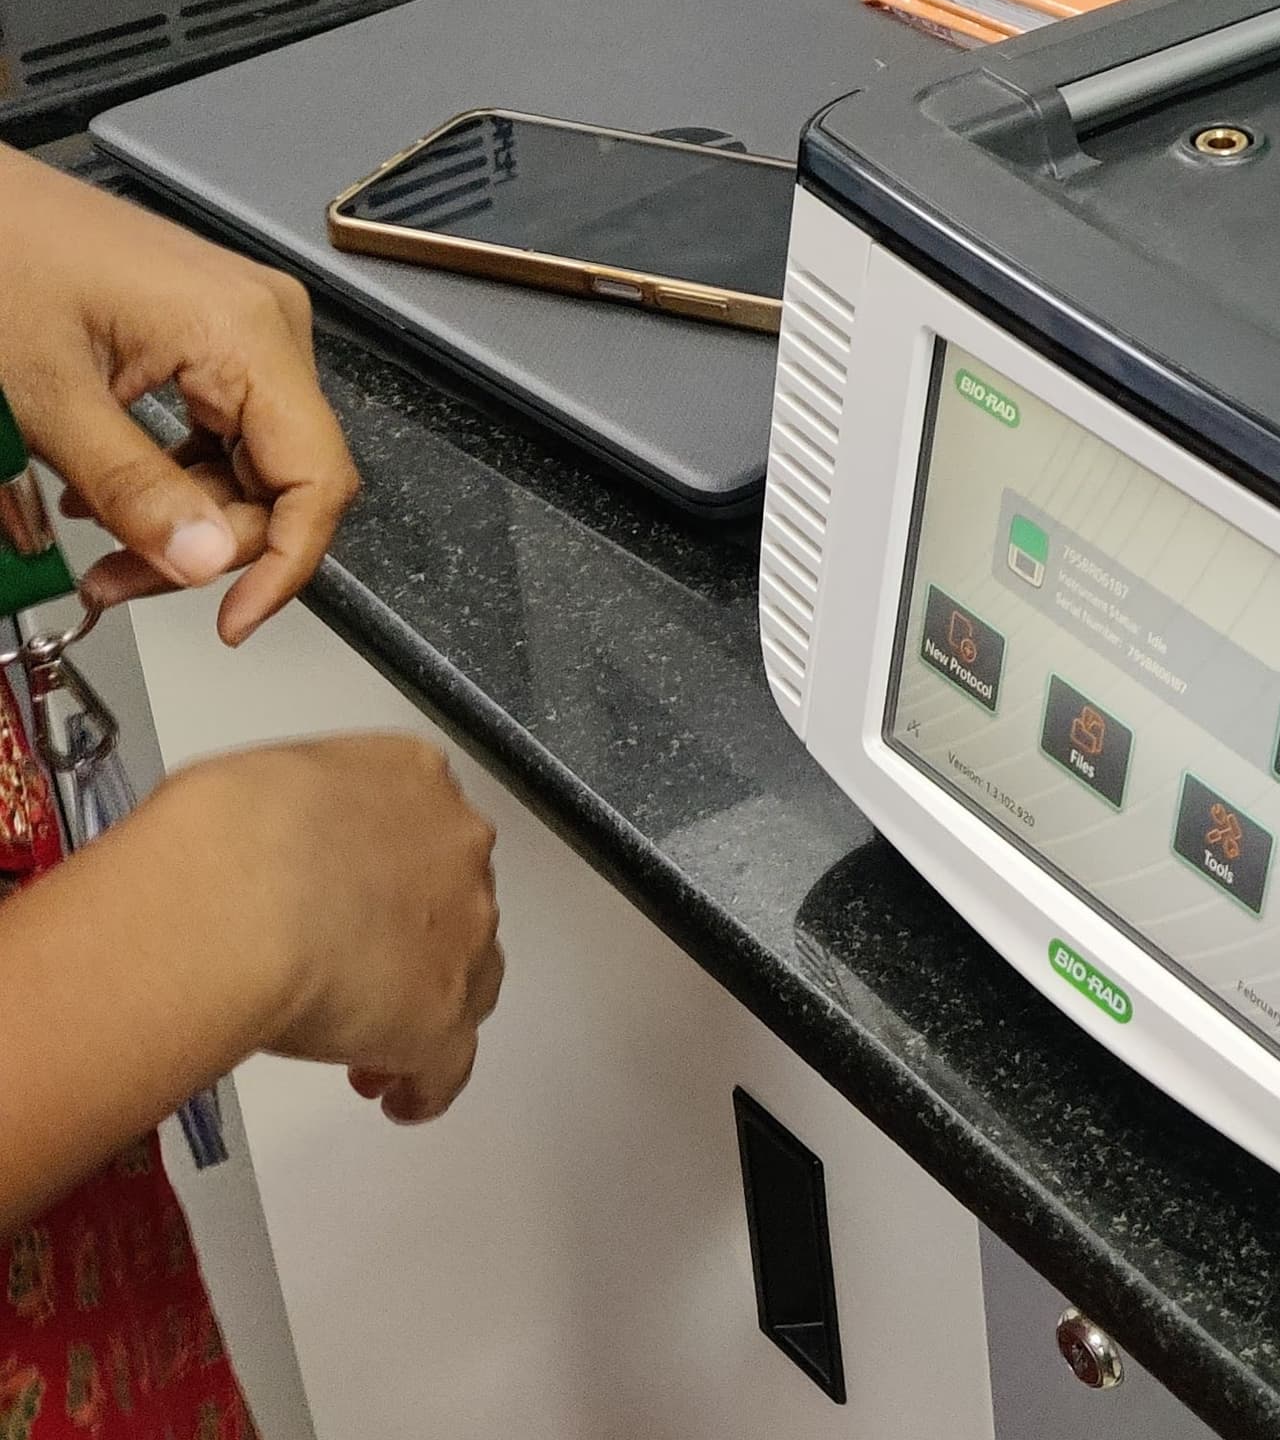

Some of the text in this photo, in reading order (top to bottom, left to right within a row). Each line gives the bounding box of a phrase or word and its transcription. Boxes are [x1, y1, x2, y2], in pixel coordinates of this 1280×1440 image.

[925, 638, 993, 700] New Protocol
[948, 751, 985, 786] Version:
[1069, 749, 1096, 779] Files
[1203, 849, 1234, 885] Tools
